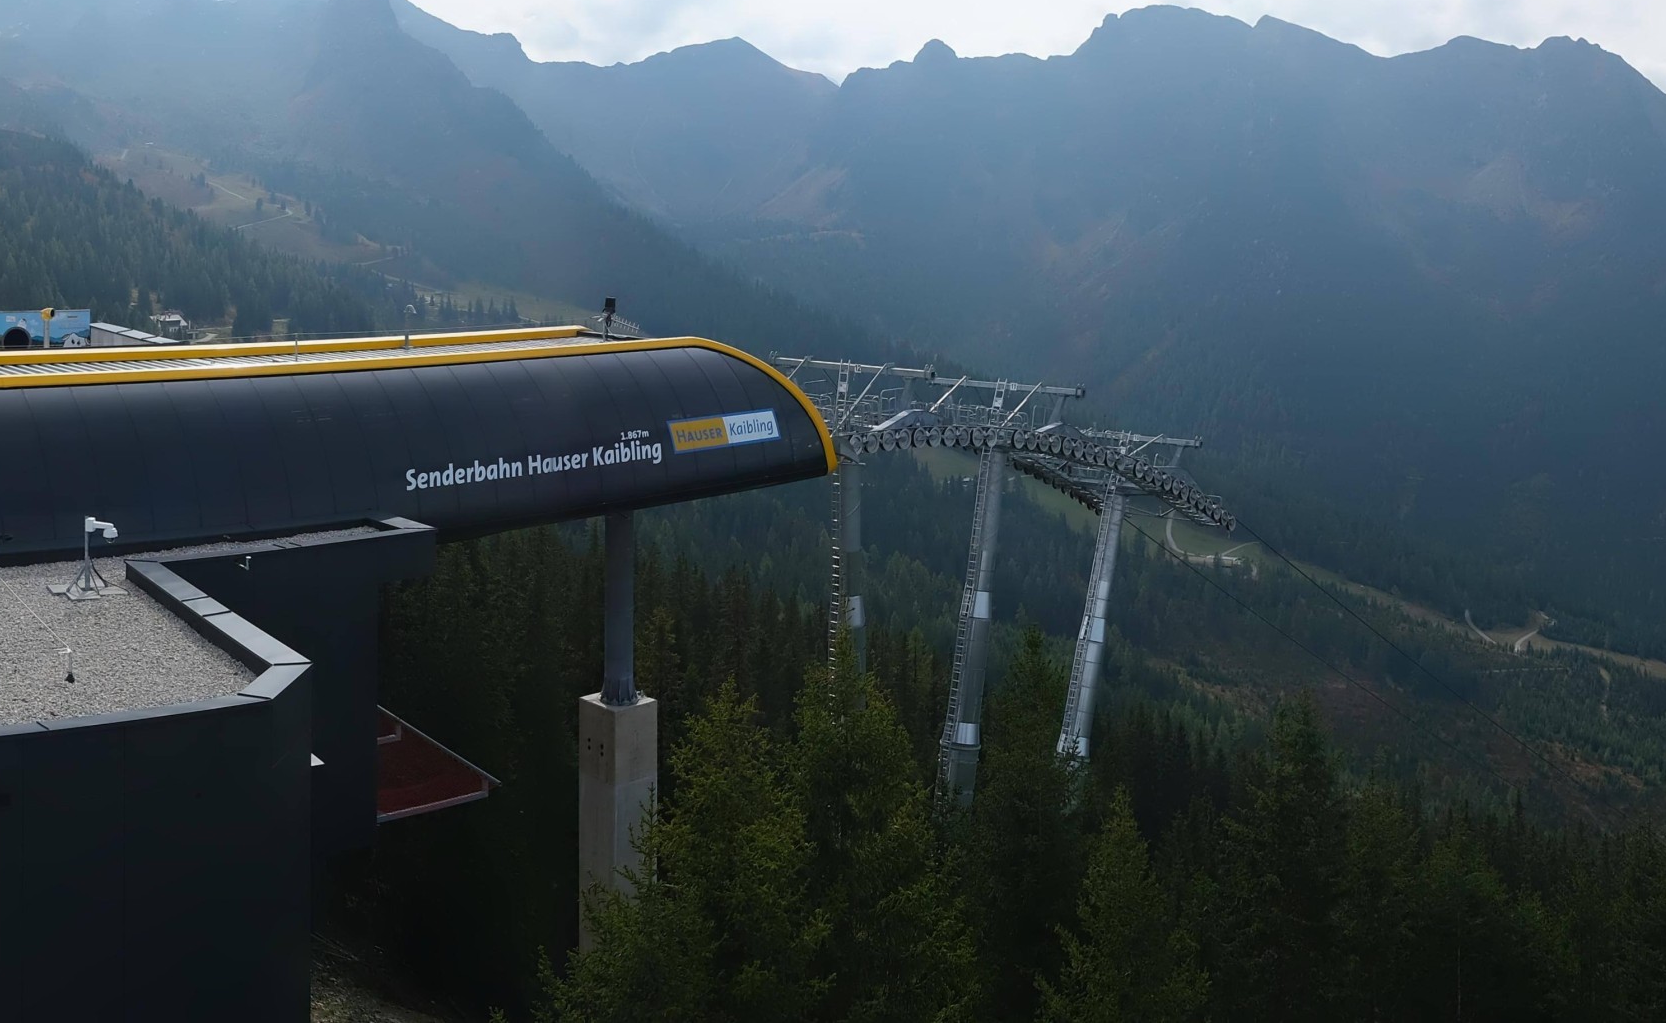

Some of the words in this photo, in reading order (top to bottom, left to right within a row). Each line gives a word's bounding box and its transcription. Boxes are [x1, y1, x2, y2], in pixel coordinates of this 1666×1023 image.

[620, 430, 650, 441] 1.867m
[675, 428, 723, 443] HAUSER
[729, 420, 773, 436] Kaibling
[406, 456, 523, 491] Senderbahn
[528, 452, 589, 476] Hauser
[593, 440, 663, 465] Kaibling
